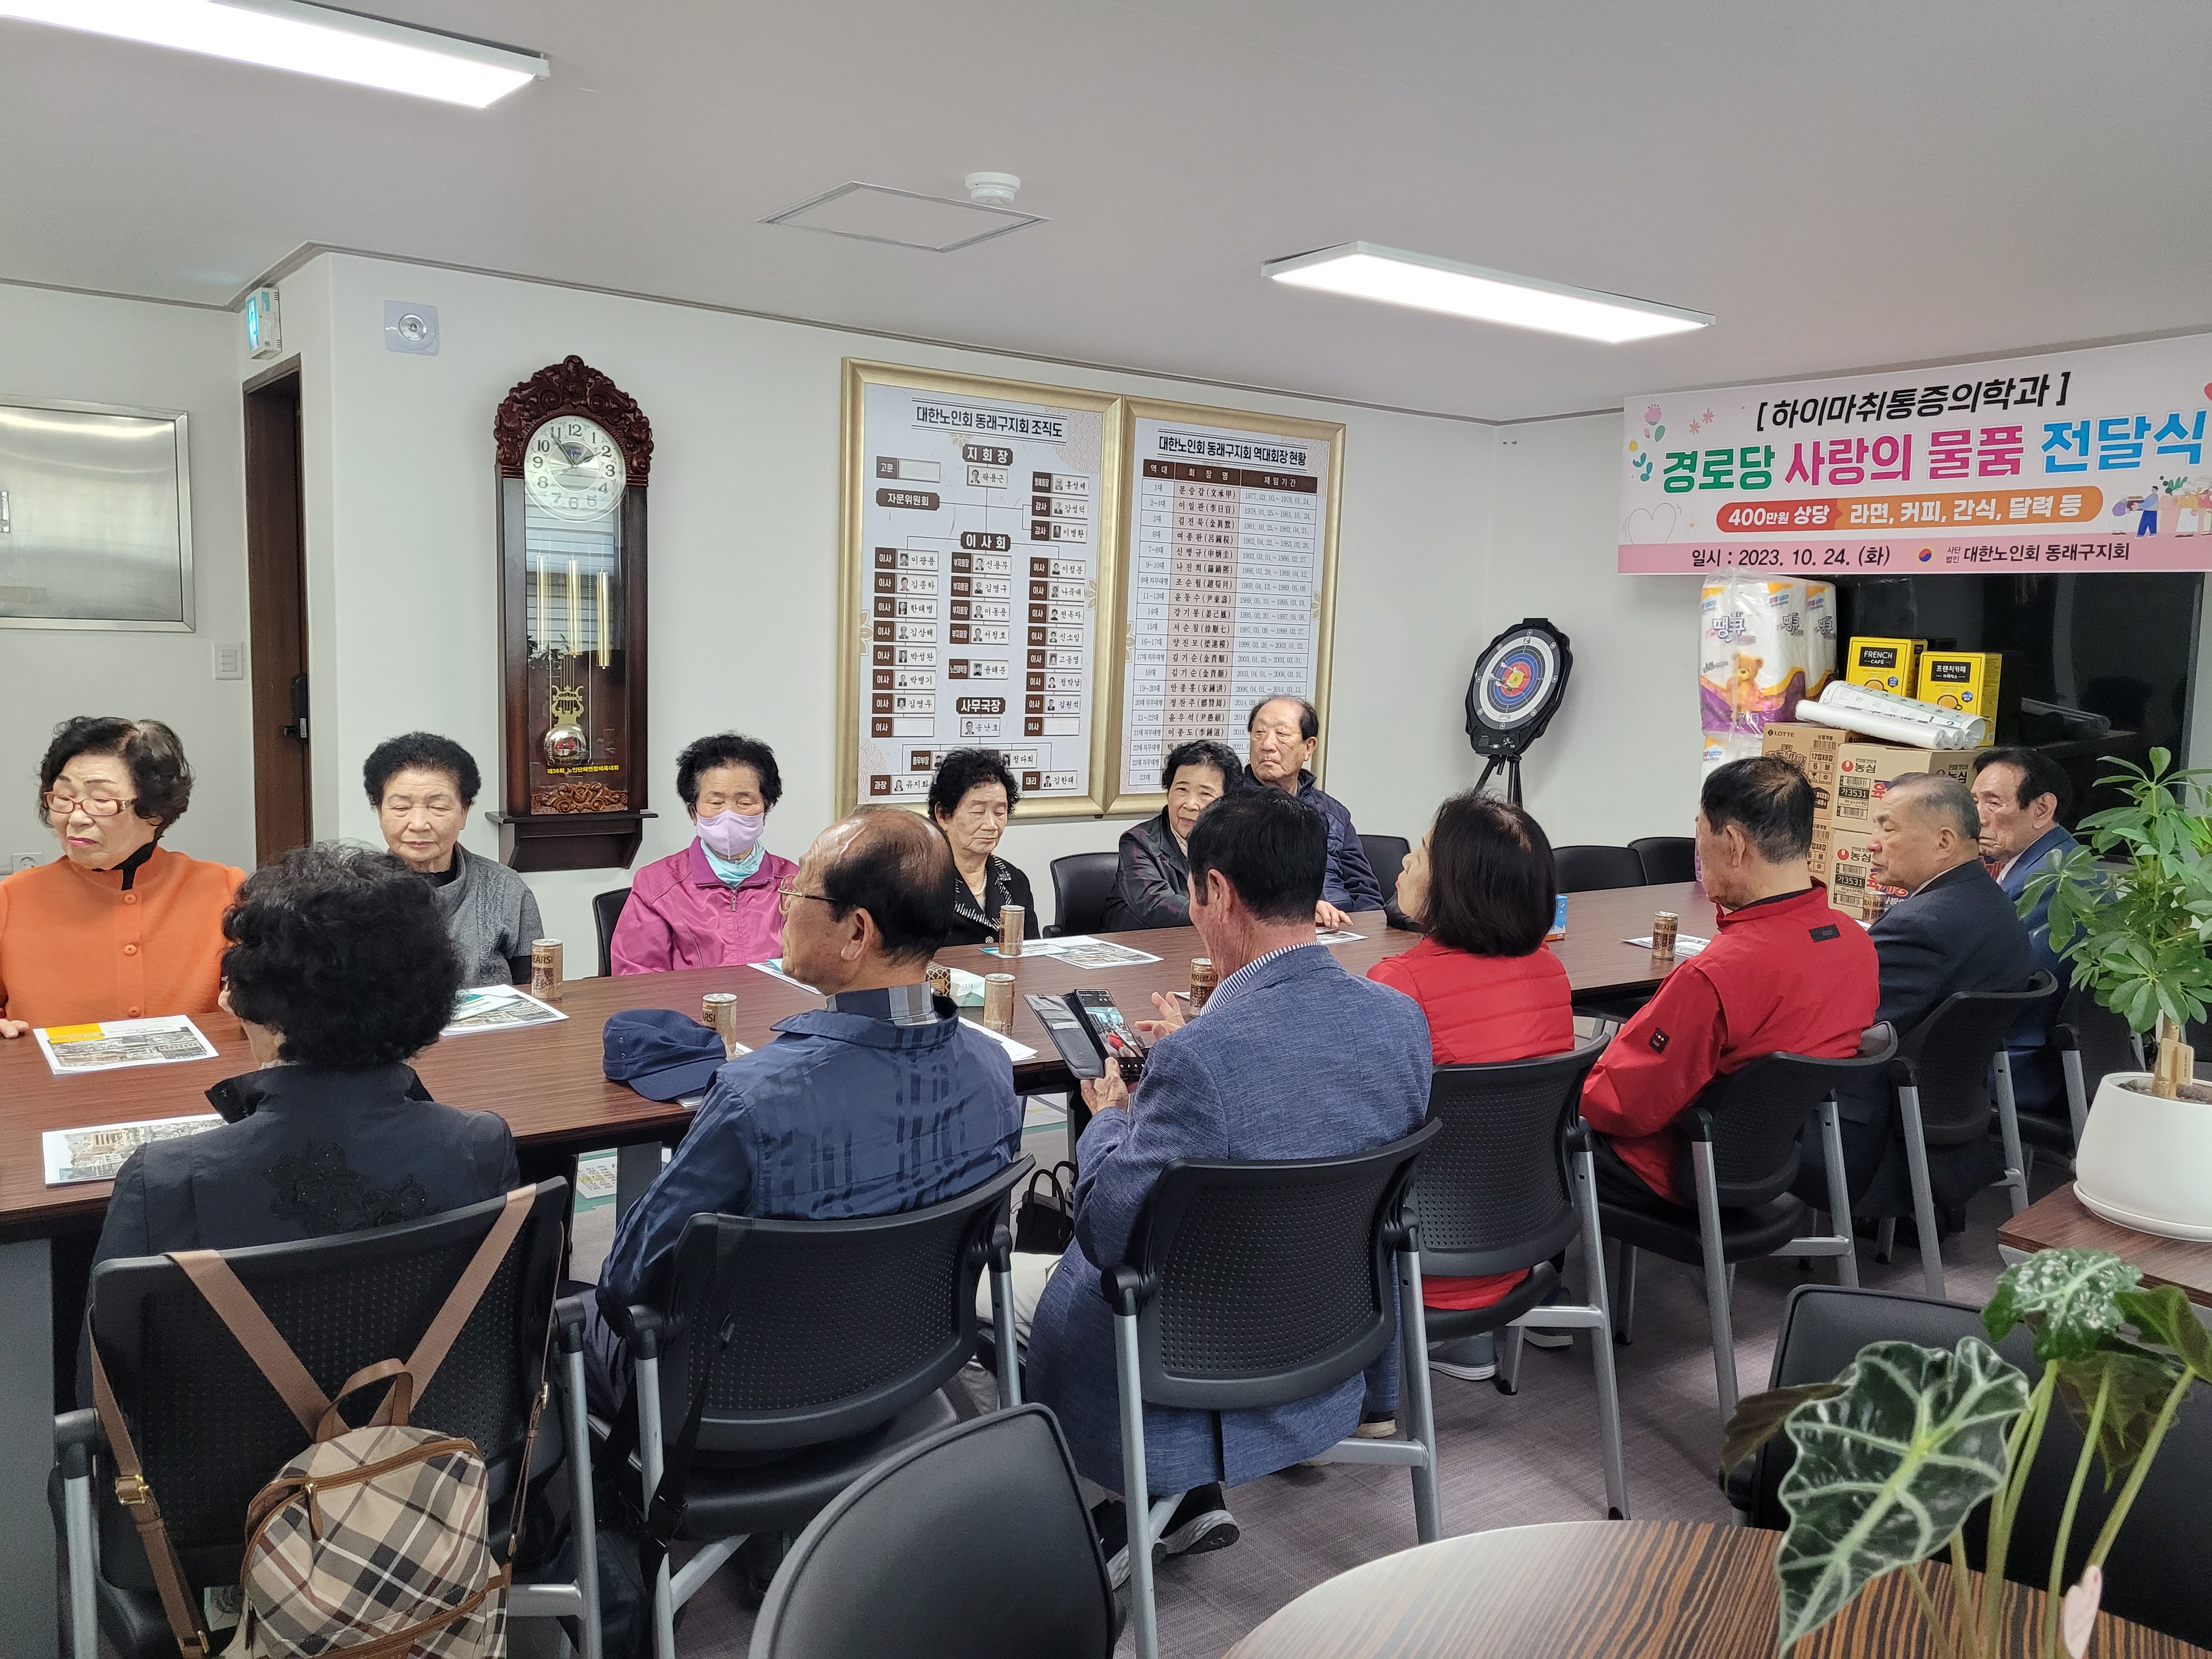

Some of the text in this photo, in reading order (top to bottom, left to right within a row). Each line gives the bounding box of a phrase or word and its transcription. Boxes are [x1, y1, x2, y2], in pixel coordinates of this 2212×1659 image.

[917, 407, 1063, 437] 대한노인회 동래구지회 조직도
[568, 424, 582, 437] 12
[592, 432, 596, 444] 1
[538, 440, 549, 452] 10
[1159, 436, 1306, 465] 대한노인회 동래구지회 역대회장 현황
[602, 446, 611, 458] 2
[967, 447, 1009, 462] 지회장
[1662, 413, 2206, 492] 경로당 사랑의 물품 전달식
[533, 456, 543, 468] 9
[605, 465, 615, 476] 3
[880, 463, 894, 473] 고문
[538, 476, 548, 488] 8
[1264, 476, 1296, 487] 재임기간
[599, 482, 608, 493] 4
[551, 492, 561, 504] 7
[569, 497, 579, 509] 6
[587, 495, 597, 507] 5
[887, 492, 929, 506] 자문위원회
[1035, 502, 1047, 511] 감사
[1729, 494, 2082, 527] 400만원 상당 라면, 커피, 간식, 달력 등
[1035, 527, 1046, 535] 감사
[966, 534, 1006, 549] 이사회
[1946, 546, 1961, 554] 사단
[1963, 543, 2130, 563] 대한노인회 동래구지회
[879, 554, 892, 563] 이사
[1691, 549, 1723, 567] 일시
[1738, 549, 1784, 567] 2023.
[1792, 549, 1816, 566] 10.
[1823, 548, 1848, 566] 24.
[1858, 546, 1890, 567] (화)
[953, 558, 969, 568] 부지회장
[1034, 563, 1045, 572] 이사
[879, 578, 891, 588] 이사
[953, 583, 969, 591] 부지회장
[1033, 586, 1044, 595] 이사
[878, 602, 891, 612] 이사
[952, 606, 968, 615] 부지회장
[1032, 610, 1043, 618] 이사
[878, 627, 890, 636] 이사
[952, 630, 967, 639] 부지회장
[1031, 632, 1043, 641] 이사
[877, 651, 890, 660] 이사
[1031, 655, 1042, 663] 이사
[1864, 650, 1893, 659] FRENCH
[1936, 665, 1966, 673] 프렌치카페
[877, 675, 889, 684] 이사
[1030, 678, 1041, 686] 이사
[877, 699, 889, 708] 이사
[961, 699, 1001, 713] 사무국장
[1029, 701, 1040, 709] 이사
[876, 723, 888, 732] 이사
[1028, 723, 1039, 731] 이사
[1854, 763, 1876, 773] 농심
[874, 781, 887, 789] 과장
[1025, 777, 1037, 785] 대리
[1841, 789, 1867, 798] 가3531
[1850, 851, 1871, 861] 농심
[1836, 876, 1863, 887] 가3531
